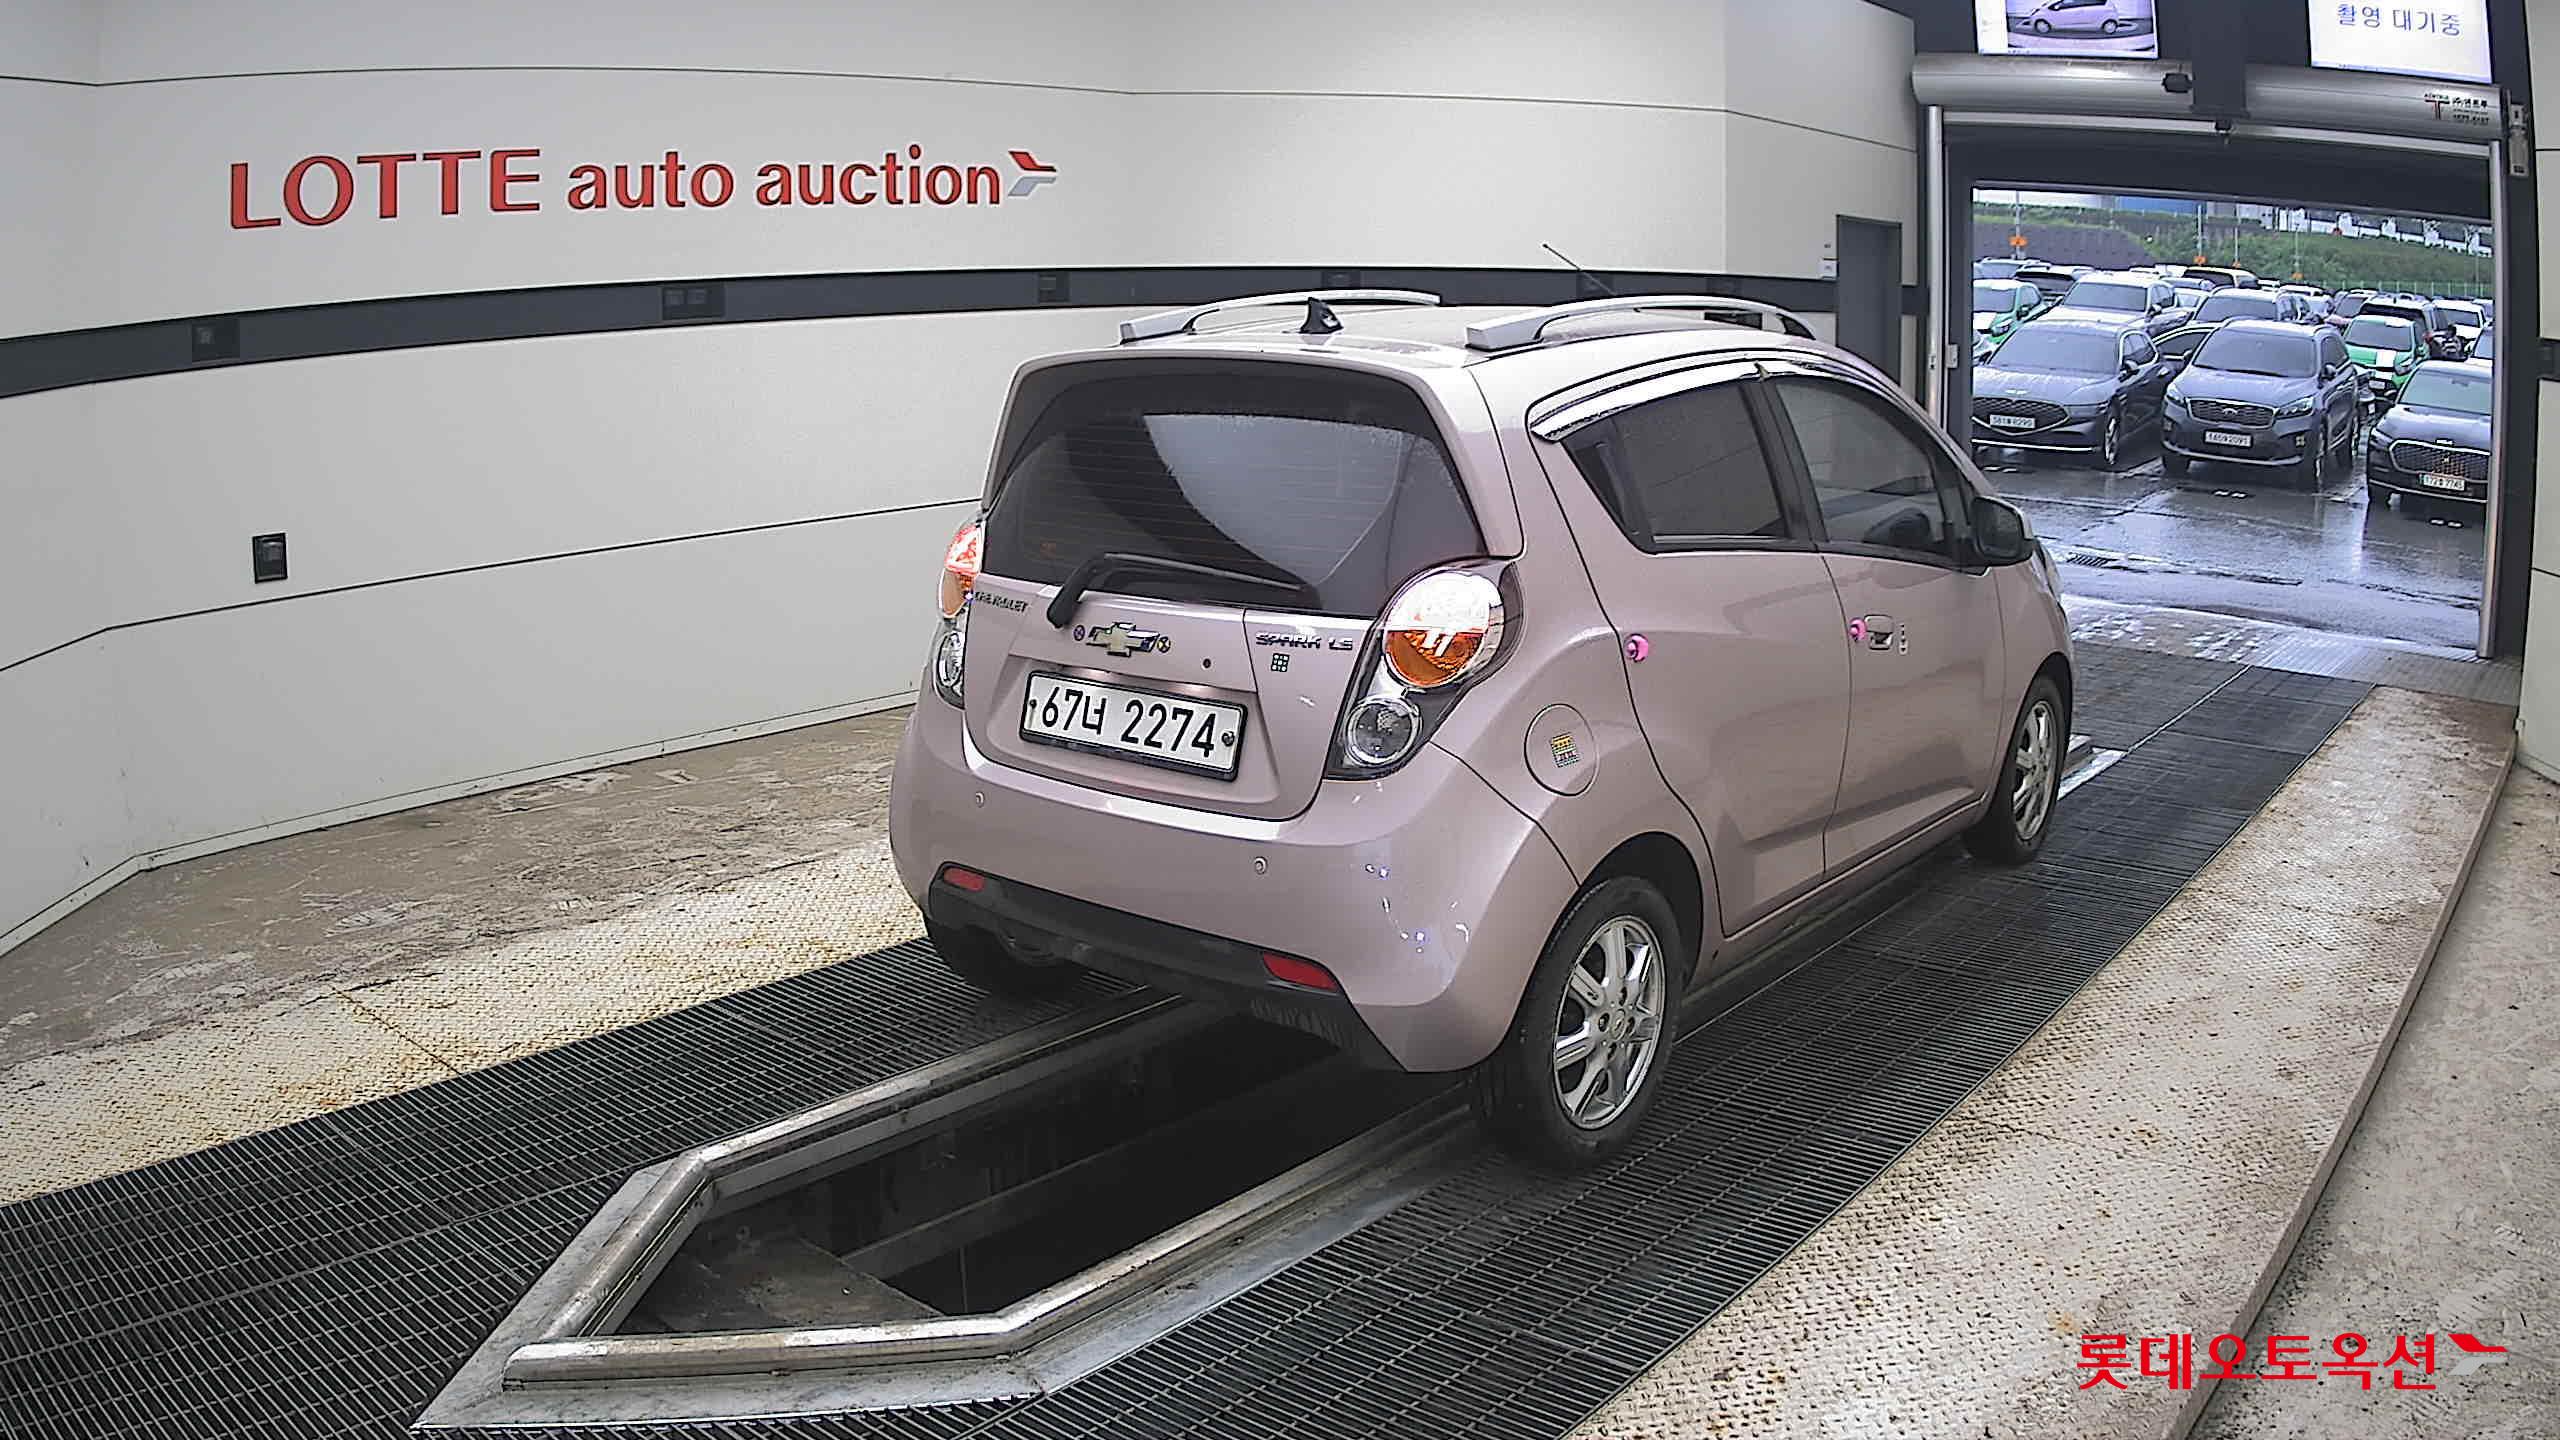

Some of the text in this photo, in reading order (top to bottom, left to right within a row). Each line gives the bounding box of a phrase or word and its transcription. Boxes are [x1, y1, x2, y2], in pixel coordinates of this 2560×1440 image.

[2337, 4, 2460, 36] 촬영 대기중
[229, 144, 1000, 230] LOTTE auto auction
[1255, 632, 1322, 649] SPARK
[1042, 686, 1216, 758] 67너 2274
